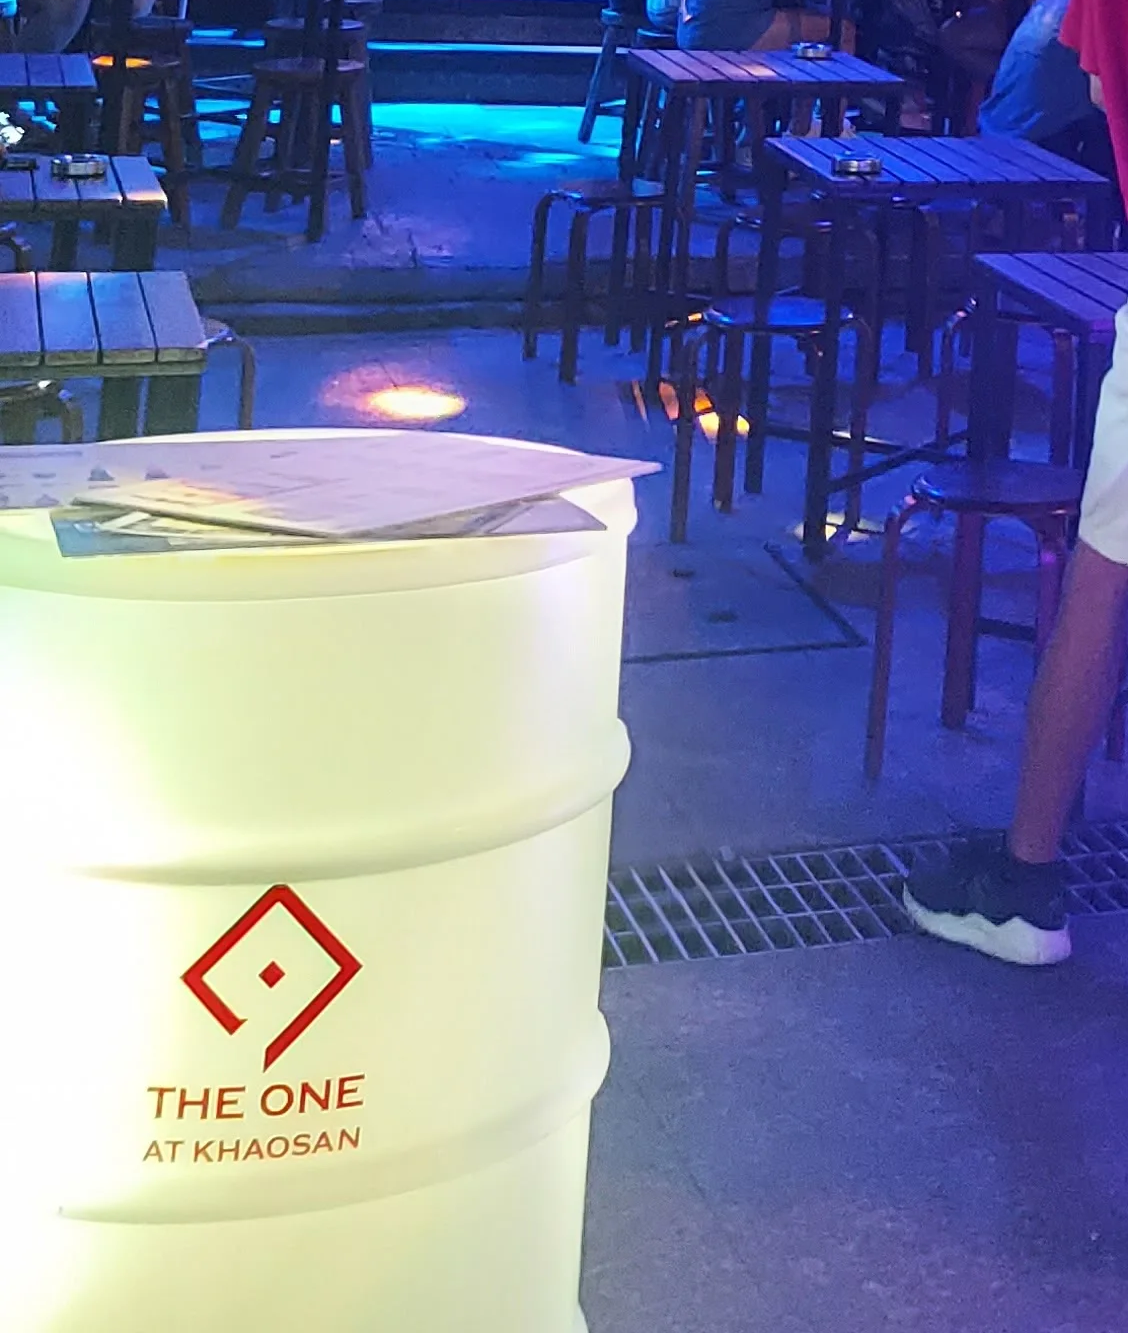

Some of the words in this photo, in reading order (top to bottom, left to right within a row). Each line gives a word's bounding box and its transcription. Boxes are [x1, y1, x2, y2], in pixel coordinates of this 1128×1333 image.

[147, 1086, 246, 1120] THE
[260, 1074, 365, 1119] ONE
[142, 1139, 185, 1163] AT
[193, 1126, 360, 1163] KHAOSAN
